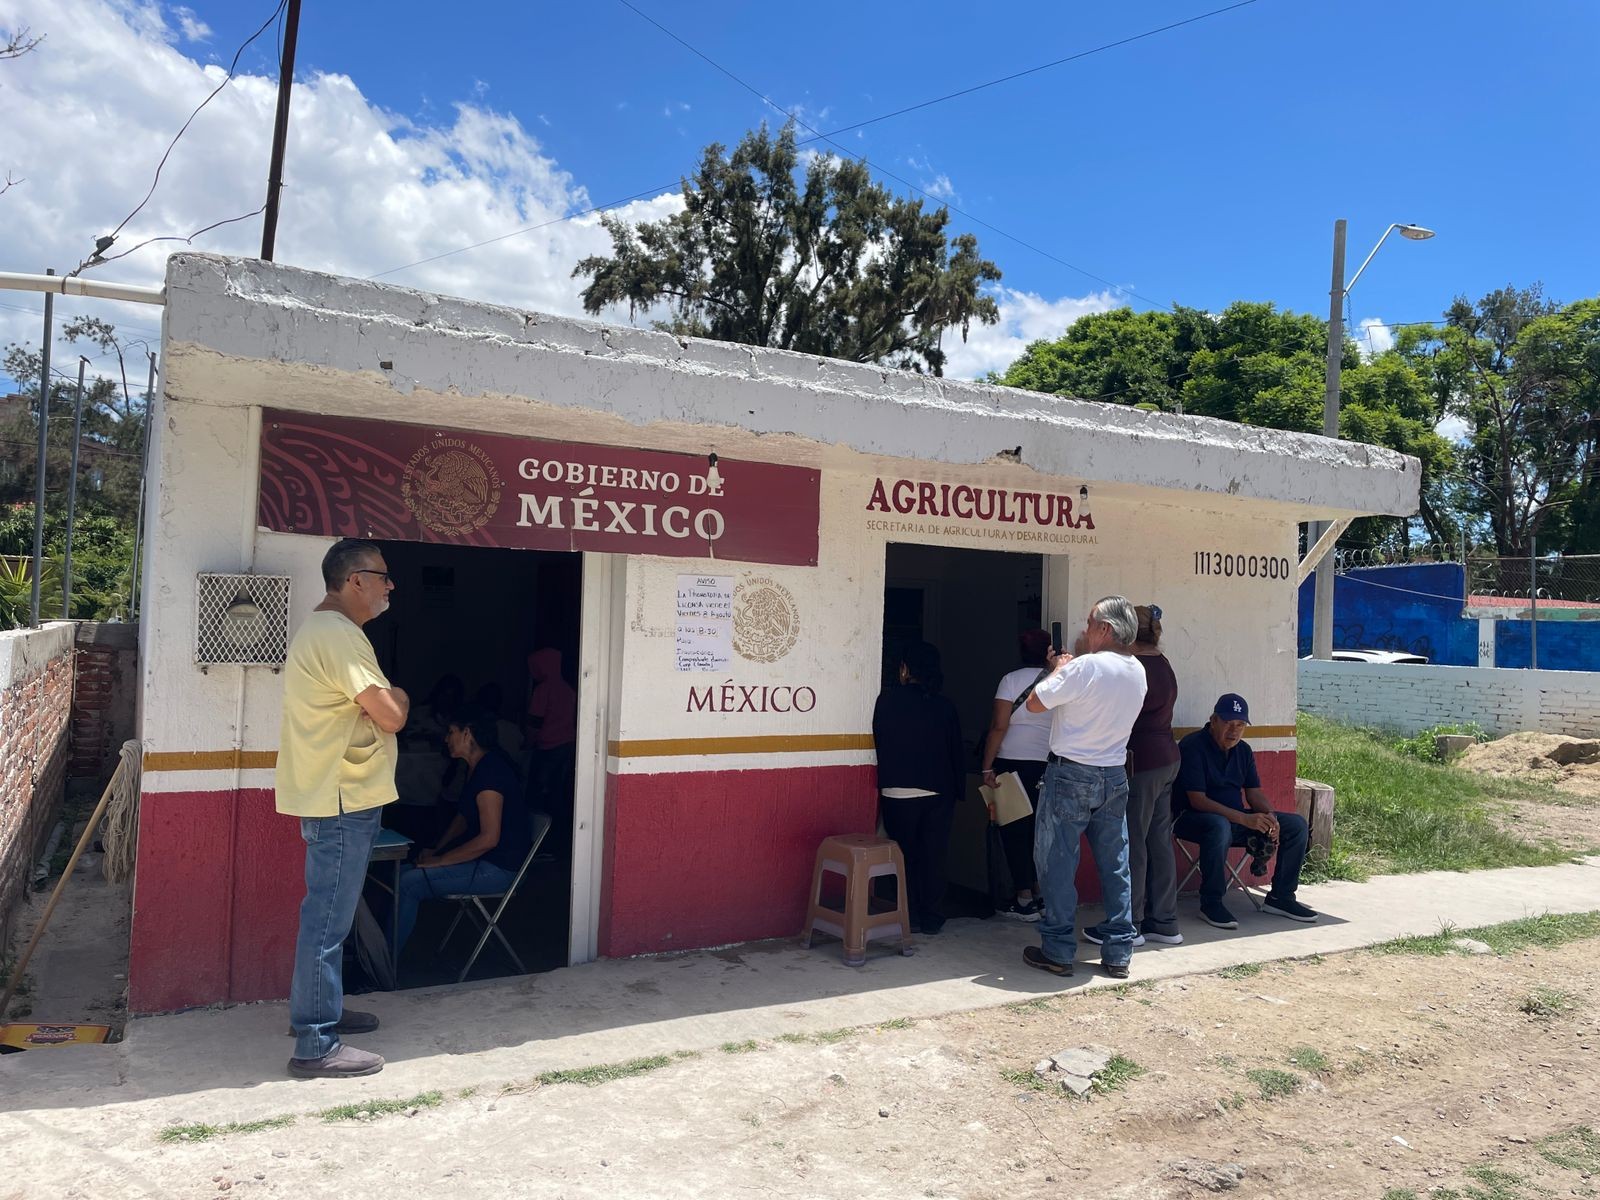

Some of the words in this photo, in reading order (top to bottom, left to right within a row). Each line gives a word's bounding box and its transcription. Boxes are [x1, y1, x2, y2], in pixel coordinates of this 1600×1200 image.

[402, 445, 430, 480] ESTADOS
[431, 438, 467, 450] UNIDOS
[467, 444, 501, 489] MEXICANOS
[518, 458, 680, 493] GOBIERNO
[688, 474, 725, 496] DE
[516, 486, 725, 540] MÉXICO
[866, 477, 1096, 530] AGRICULTURA
[866, 520, 925, 534] SECRETARIA
[928, 524, 940, 535] DE
[943, 525, 1008, 540] AGRICULTURA
[1008, 530, 1016, 540] Y
[1071, 534, 1099, 545] RURAL
[696, 577, 716, 585] AVISO
[746, 576, 774, 587] UNIDOS
[1194, 551, 1290, 580] 1113000300
[686, 678, 817, 713] MÉXICO
[1232, 700, 1242, 713] LA
